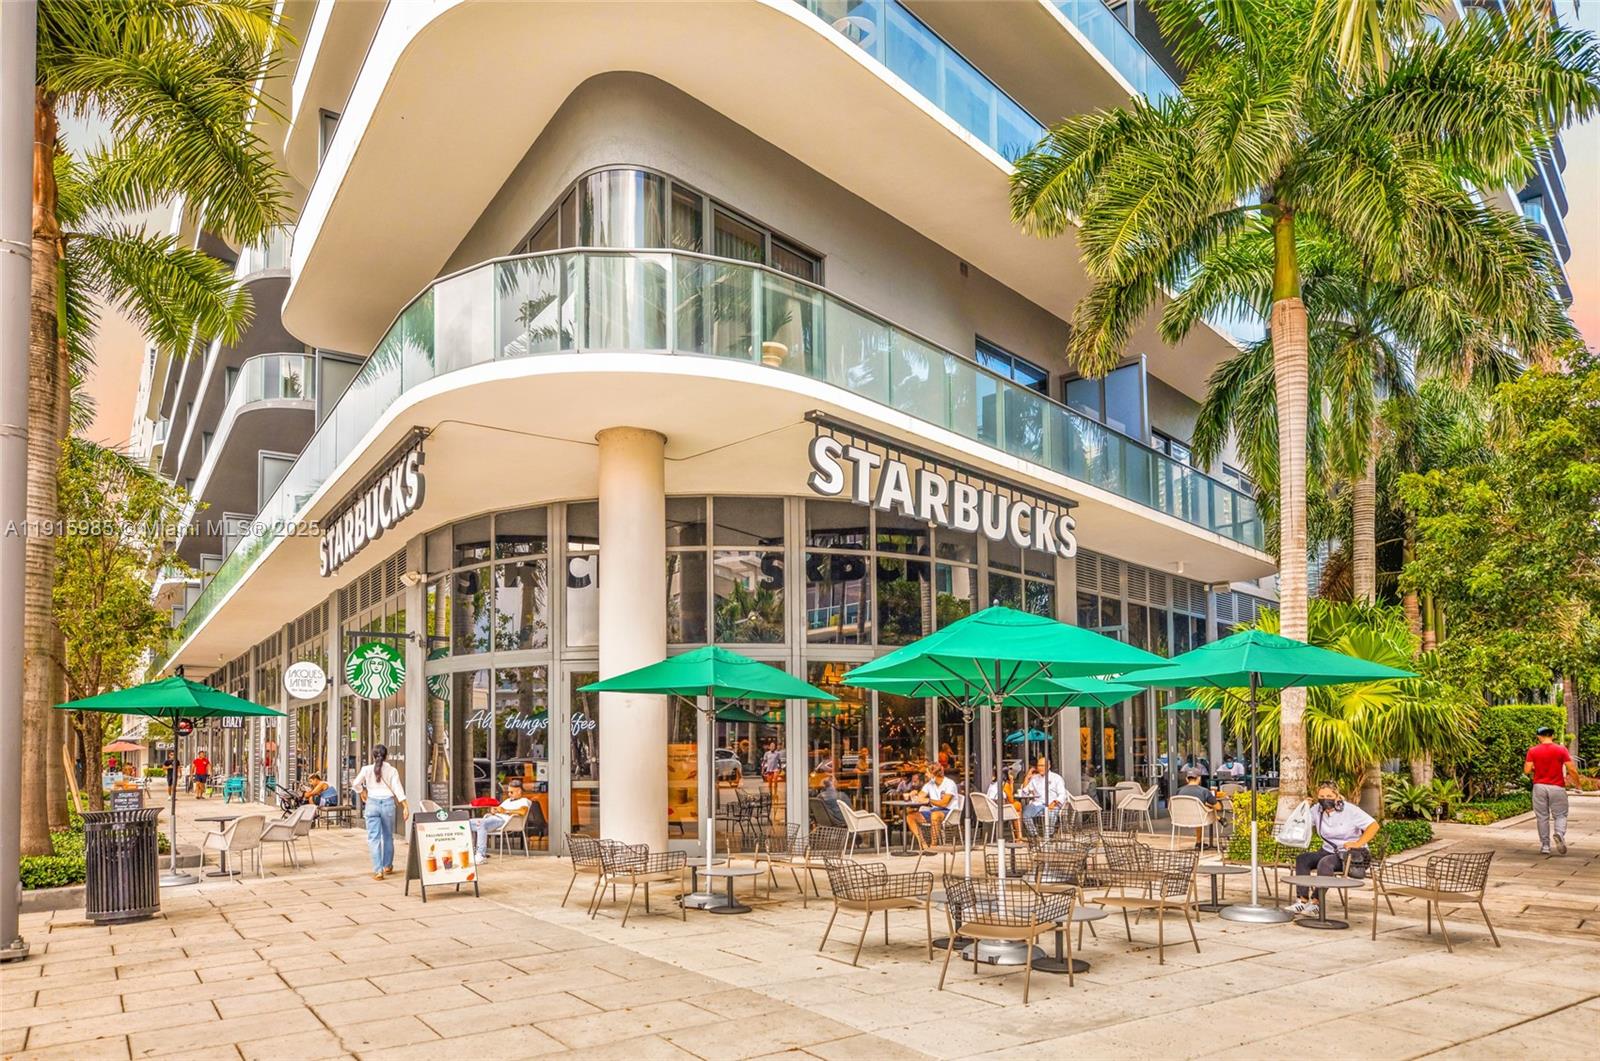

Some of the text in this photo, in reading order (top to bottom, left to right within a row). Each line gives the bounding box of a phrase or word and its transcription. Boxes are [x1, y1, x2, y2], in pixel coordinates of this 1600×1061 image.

[808, 435, 1078, 558] STARBUCKS
[319, 451, 426, 578] STARBUCKS
[288, 669, 323, 679] JACQUES
[222, 716, 243, 728] CRAZY
[504, 711, 549, 736] things
[570, 711, 597, 737] ffee
